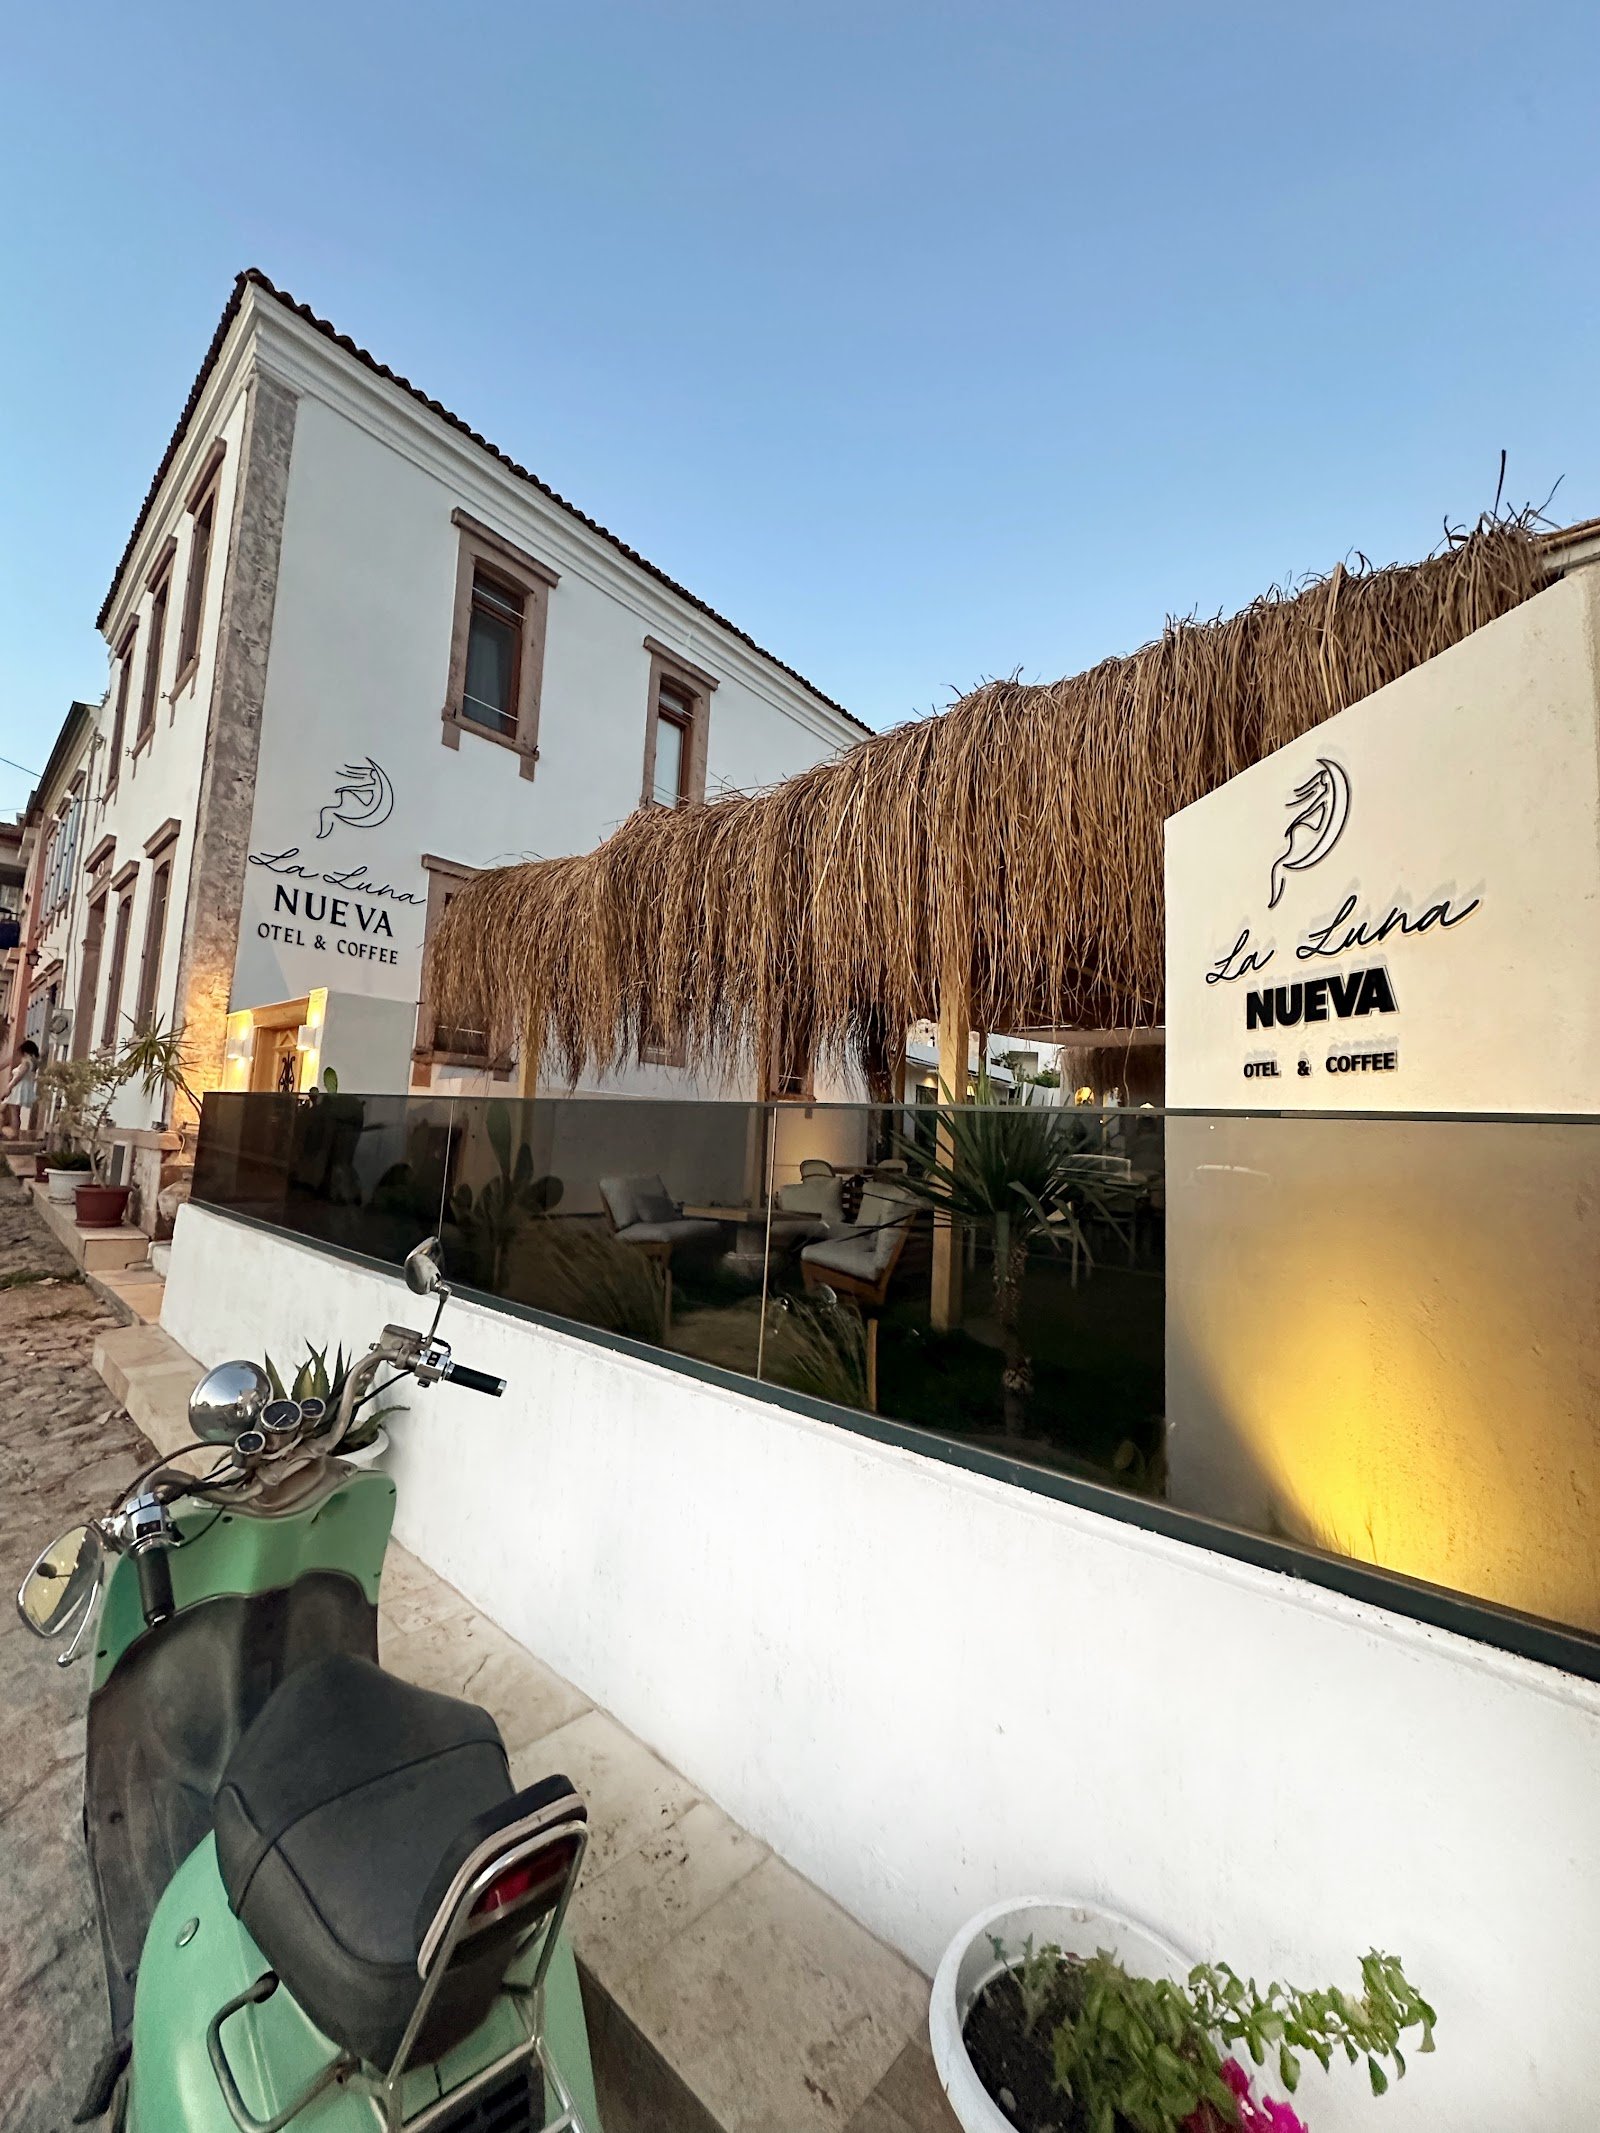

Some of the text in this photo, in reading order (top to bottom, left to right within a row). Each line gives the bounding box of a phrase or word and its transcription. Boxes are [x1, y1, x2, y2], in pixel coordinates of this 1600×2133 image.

[249, 848, 426, 904] La Luna
[274, 884, 393, 937] NUEVA
[258, 922, 398, 965] OTEL & COFFEE
[1206, 895, 1479, 983] La Luna
[1246, 965, 1399, 1030] NUEVA
[1243, 1052, 1396, 1078] OTEL & COFFEE
